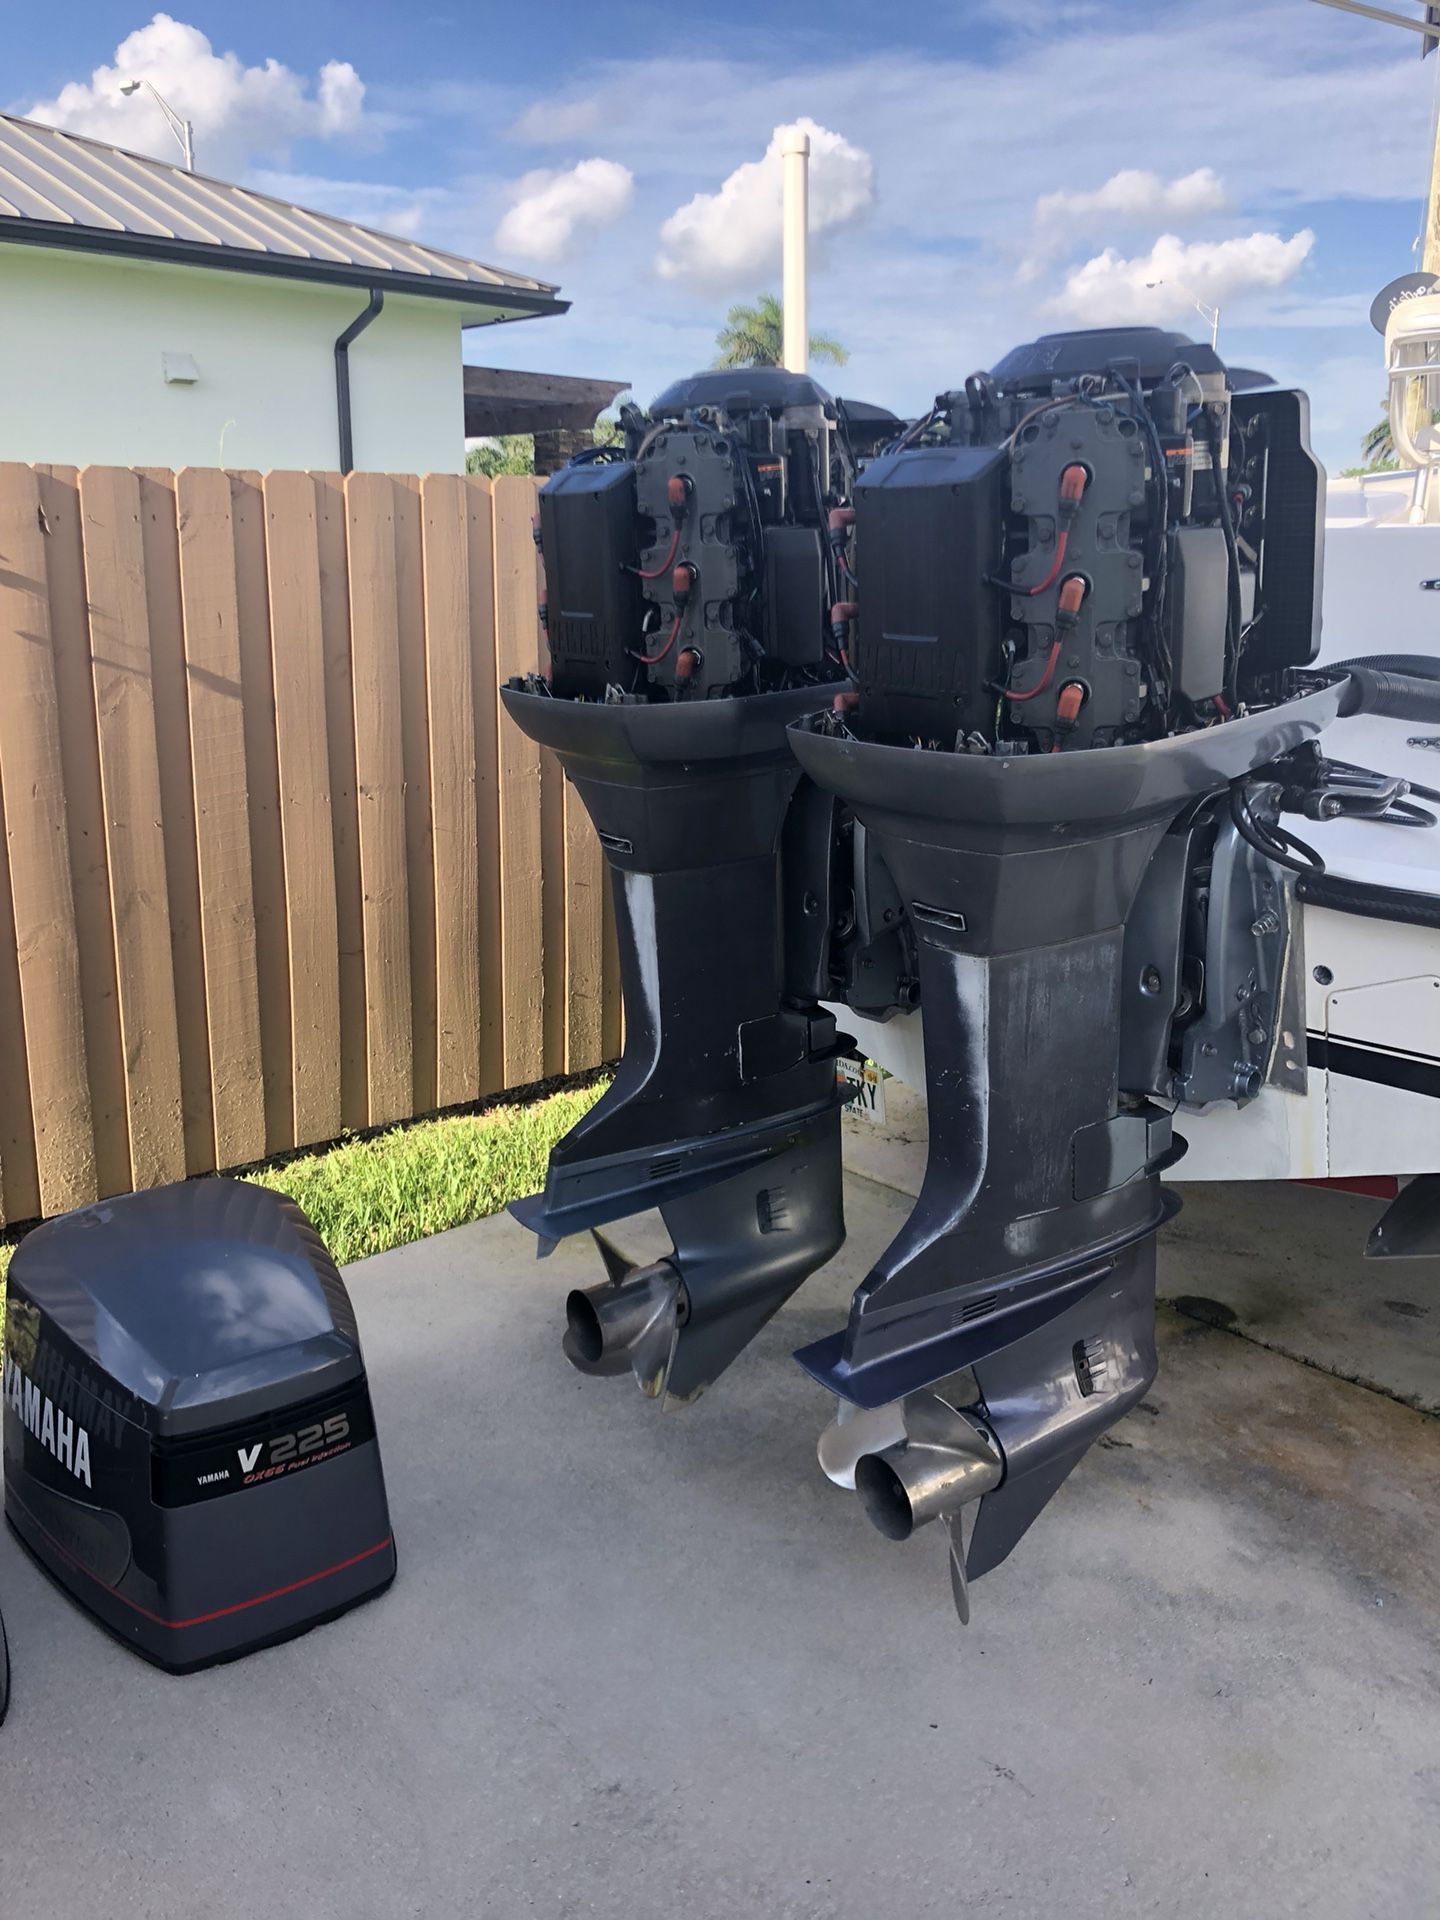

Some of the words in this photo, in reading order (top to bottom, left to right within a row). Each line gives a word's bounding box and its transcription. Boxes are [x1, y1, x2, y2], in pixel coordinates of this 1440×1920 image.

[845, 1104, 863, 1118] STATE
[4, 1350, 92, 1489] YAMAHA
[197, 1470, 230, 1485] YAMAHA
